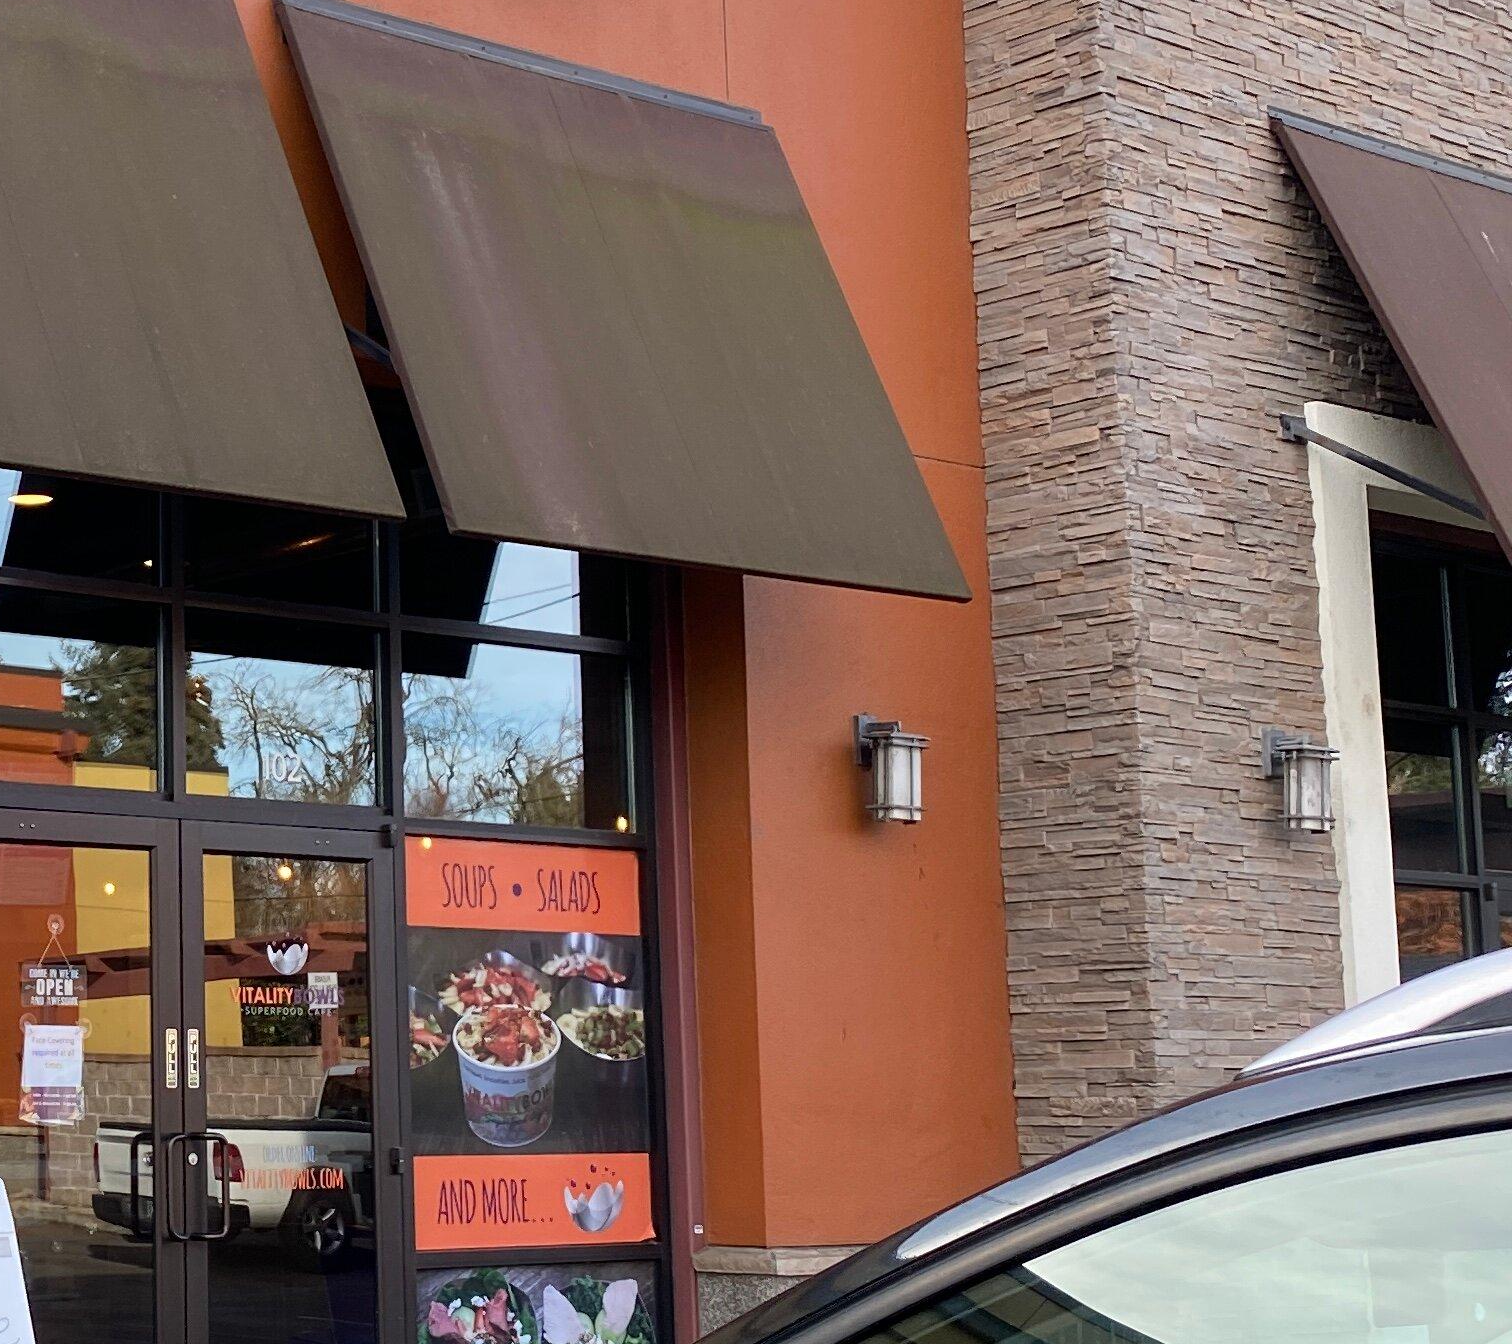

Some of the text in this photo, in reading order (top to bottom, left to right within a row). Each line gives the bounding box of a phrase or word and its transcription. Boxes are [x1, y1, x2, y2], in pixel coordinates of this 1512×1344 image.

[262, 751, 302, 783] 102
[442, 862, 601, 914] SOUPS SALADS
[36, 978, 74, 996] OPEN
[245, 1006, 304, 1017] SUPERFOOD
[437, 1179, 476, 1224] AND
